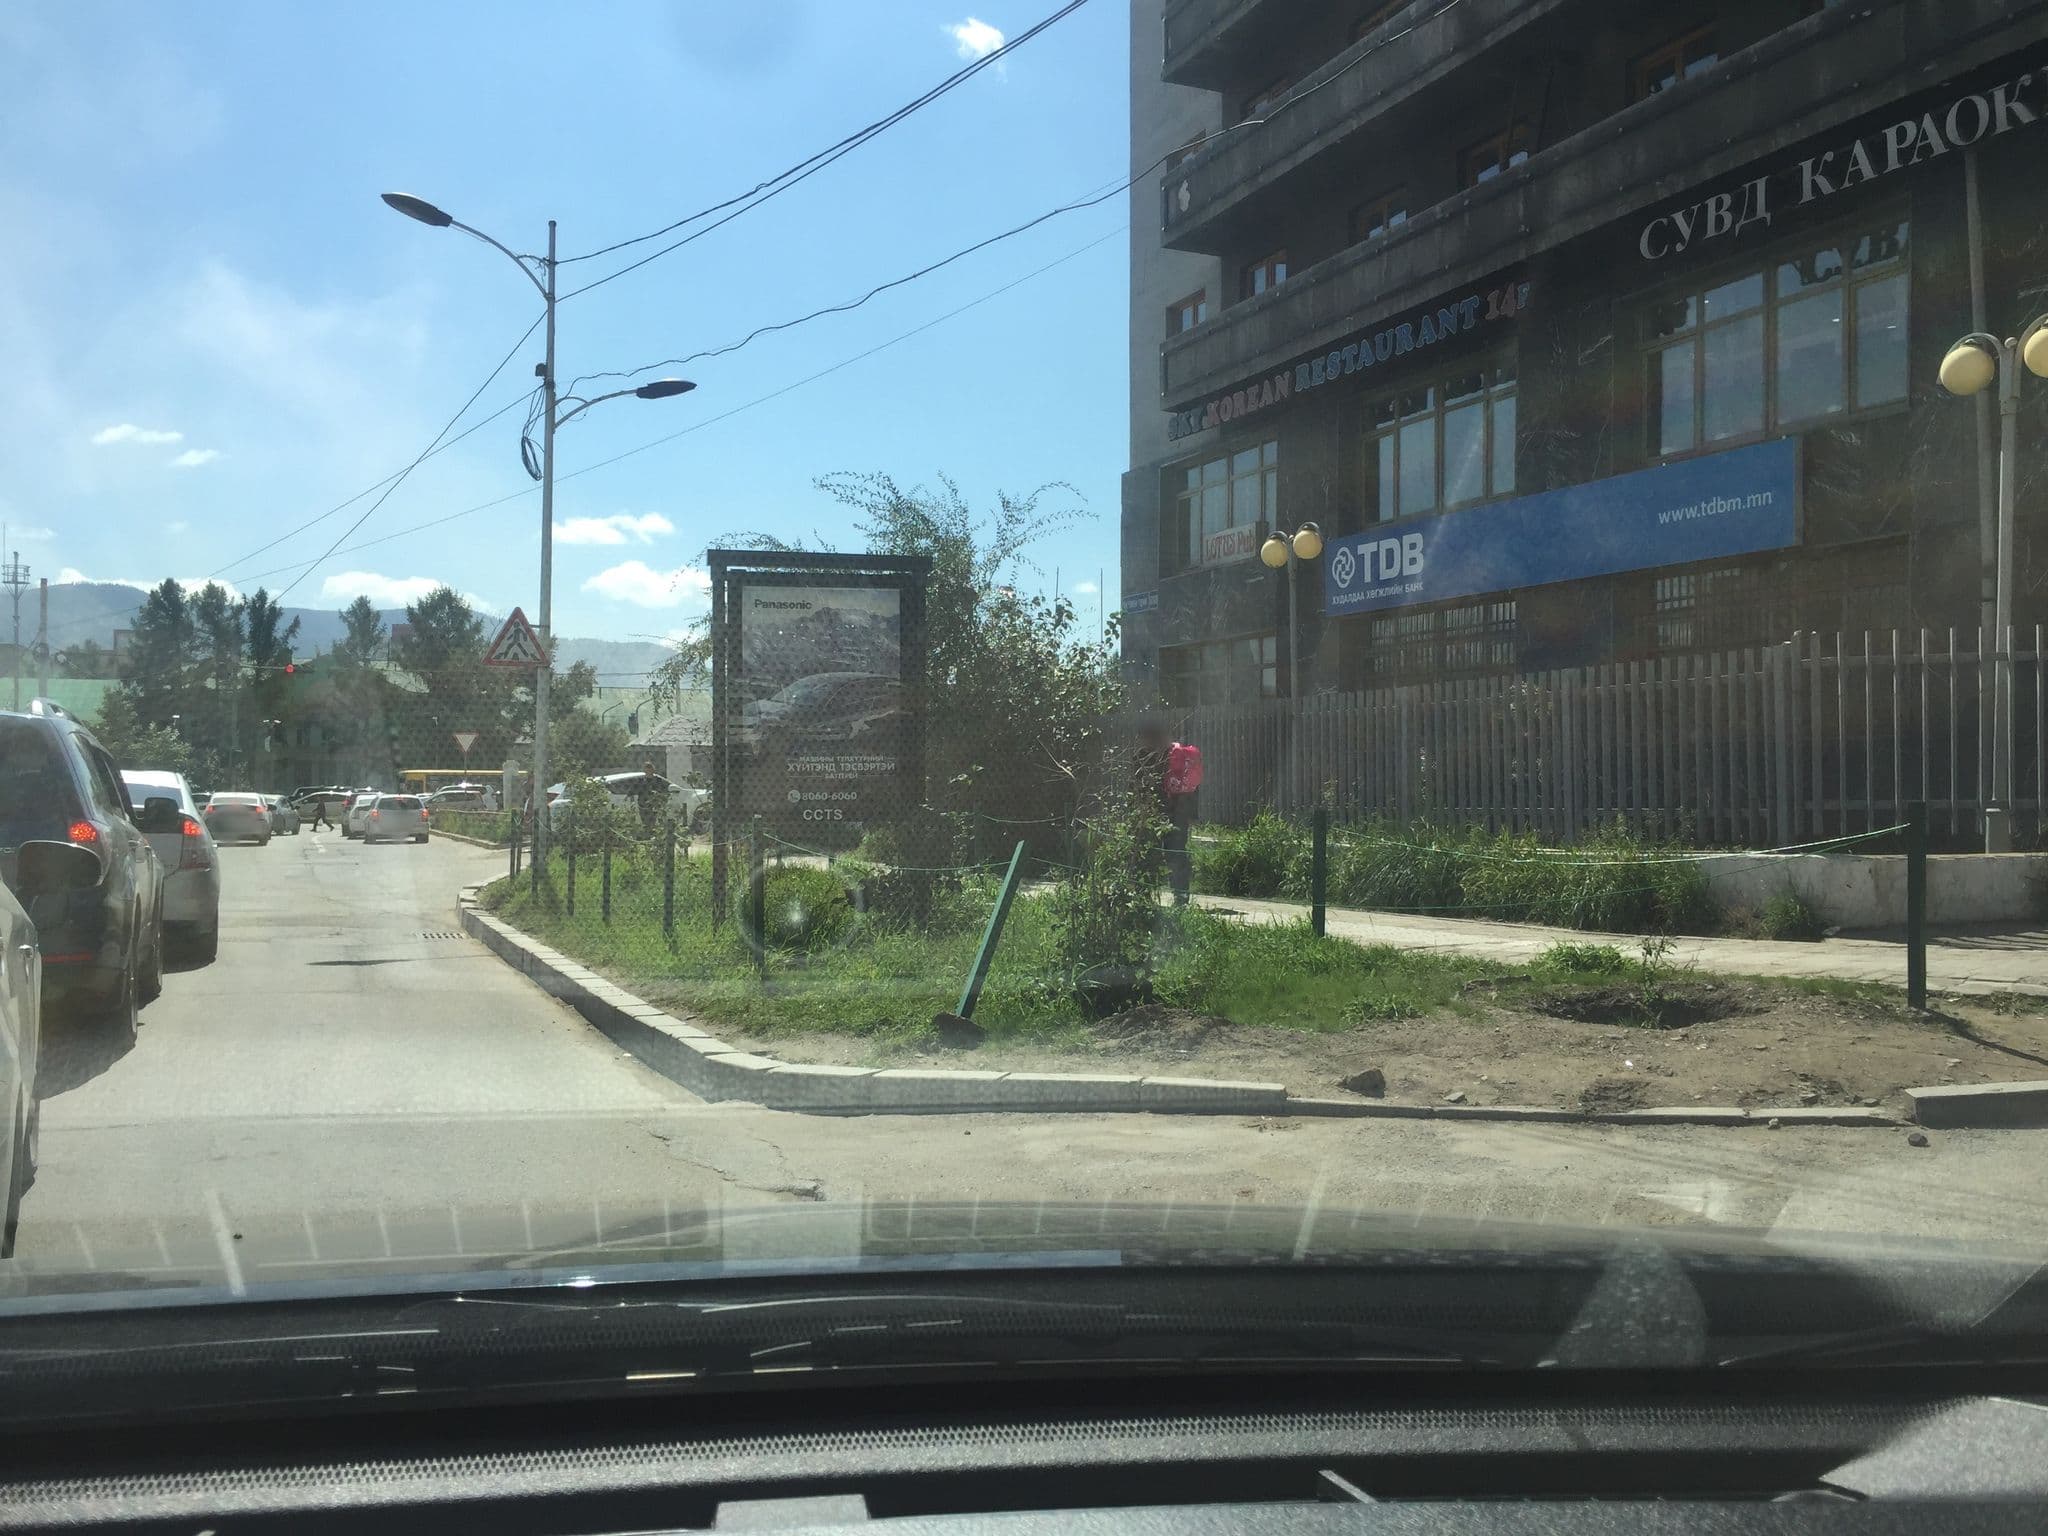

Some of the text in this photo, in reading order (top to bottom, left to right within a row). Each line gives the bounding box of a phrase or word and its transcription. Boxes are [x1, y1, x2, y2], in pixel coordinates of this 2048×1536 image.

[1639, 64, 2048, 261] СУВД КАРАОК
[1206, 371, 1291, 426] KOREAN
[1294, 294, 1480, 393] RESTAURANT
[1657, 490, 1773, 524] www.tdbm.mn
[1357, 532, 1424, 584] TDB
[754, 598, 813, 610] Panasonic
[1331, 591, 1365, 605] ХУДАЛДАА
[1405, 581, 1424, 593] БАНК
[840, 761, 896, 772] ТЭСВЭРТЭЙ
[801, 791, 858, 801] 8060-6060
[803, 809, 844, 820] CCTS
